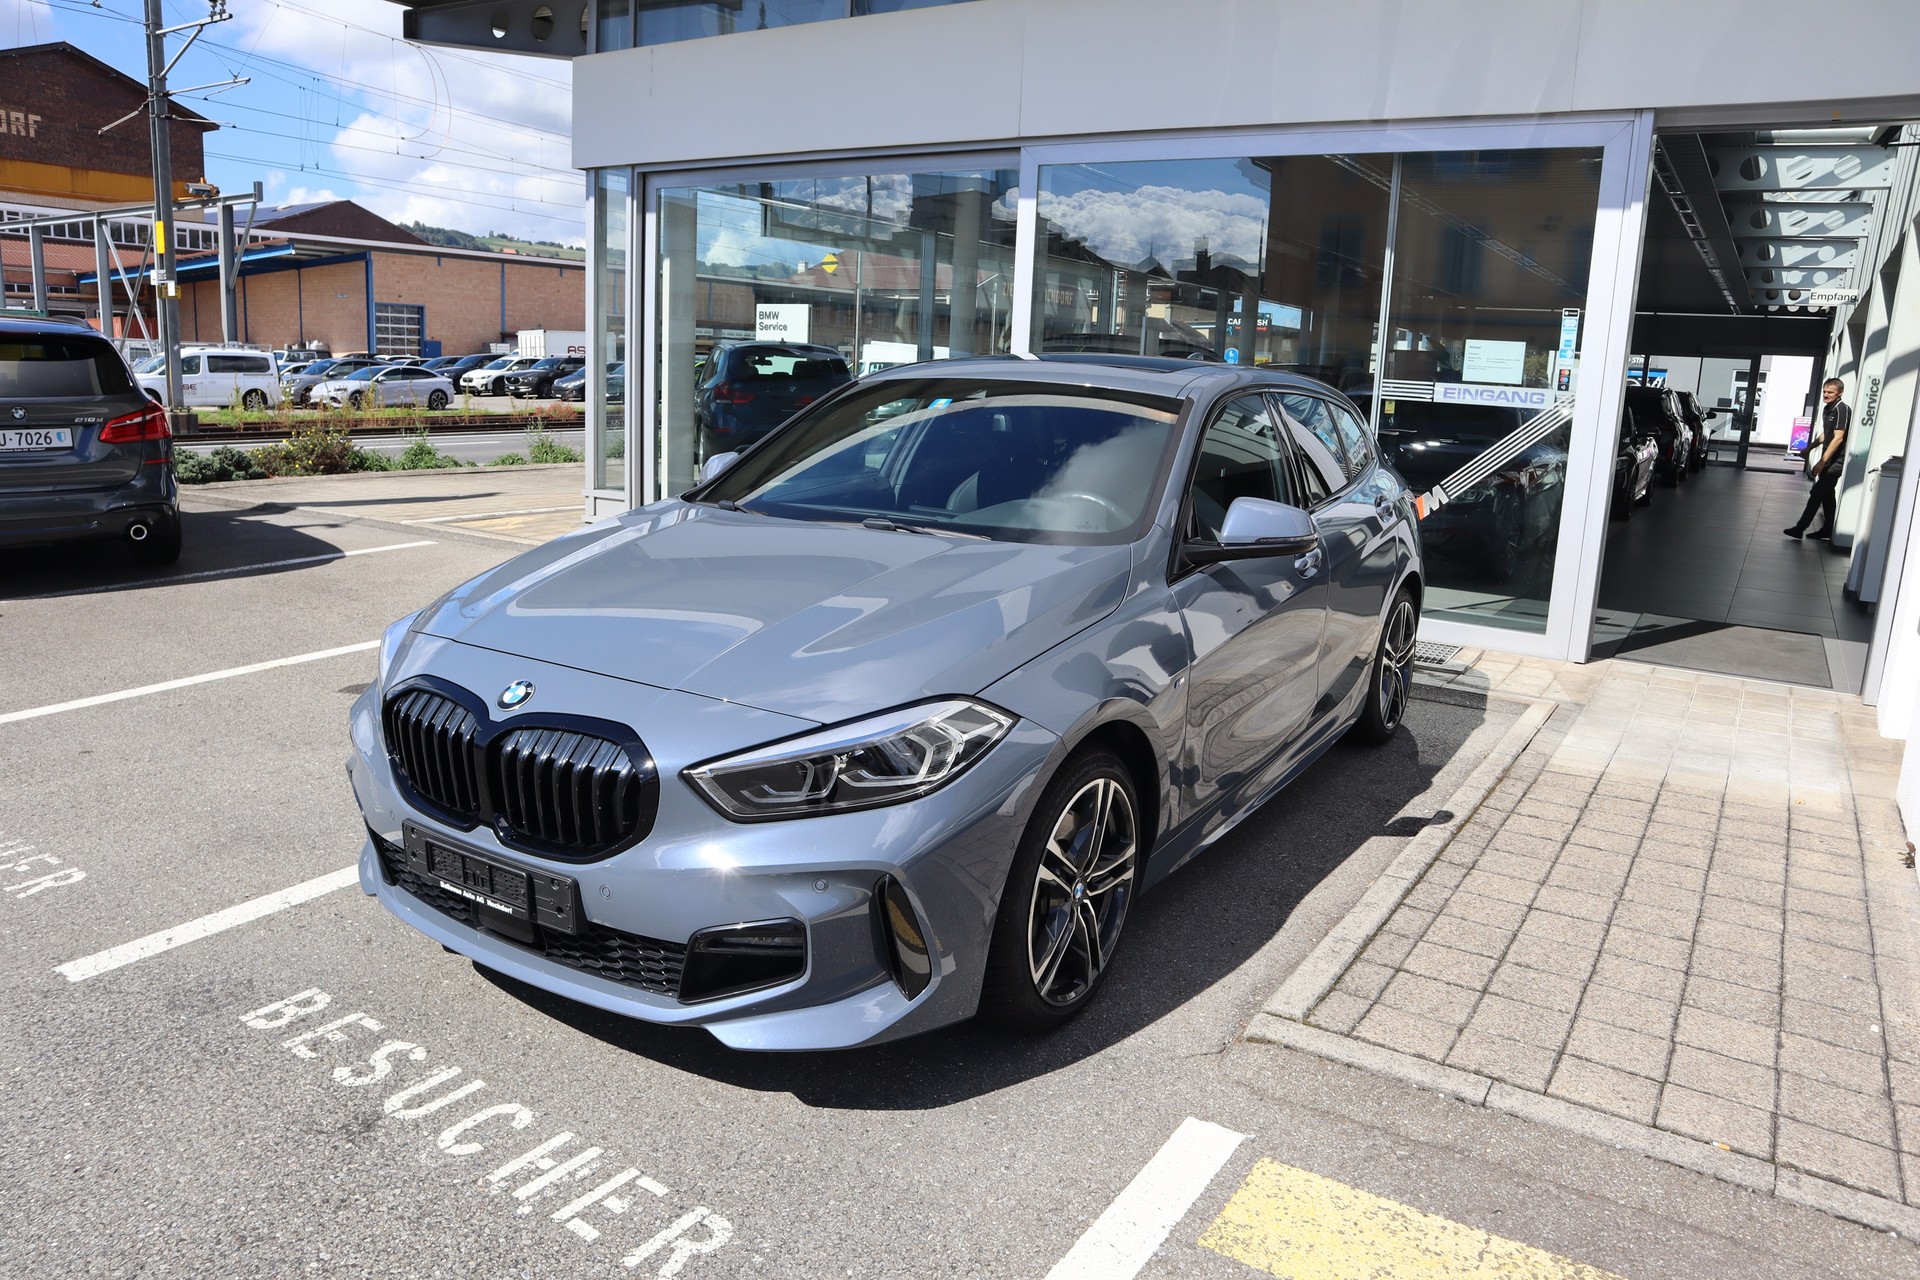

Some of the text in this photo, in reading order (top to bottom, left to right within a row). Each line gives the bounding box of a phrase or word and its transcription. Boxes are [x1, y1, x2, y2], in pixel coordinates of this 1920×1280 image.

[1810, 291, 1858, 303] Empfang
[758, 311, 780, 320] BMW
[758, 321, 788, 331] Service
[567, 345, 586, 354] AS
[1442, 386, 1546, 405] EINGANG
[1861, 377, 1881, 427] Service
[238, 987, 734, 1280] BESUCHER
